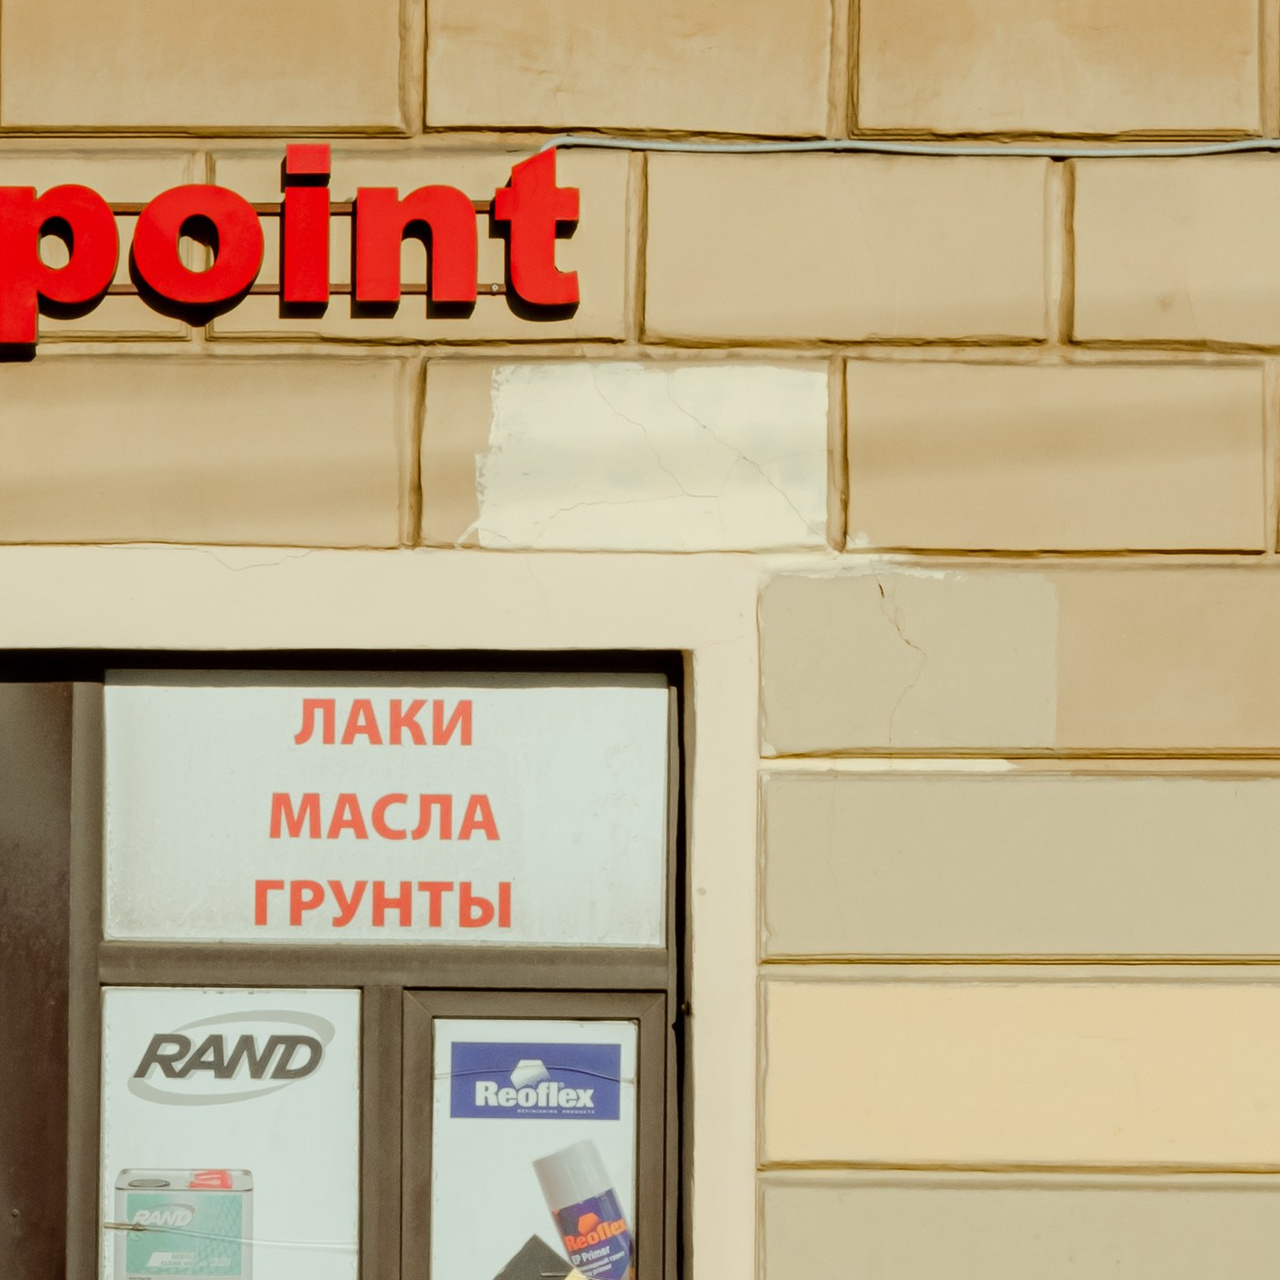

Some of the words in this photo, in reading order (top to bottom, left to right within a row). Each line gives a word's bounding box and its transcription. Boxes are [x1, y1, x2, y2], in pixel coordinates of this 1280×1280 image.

[294, 698, 474, 747] ЛАКИ
[269, 792, 500, 842] МАСЛА
[254, 879, 513, 929] ГРУНТЫ
[132, 1032, 324, 1080] RAND
[475, 1080, 595, 1108] Reoflex
[132, 1209, 194, 1227] RAND
